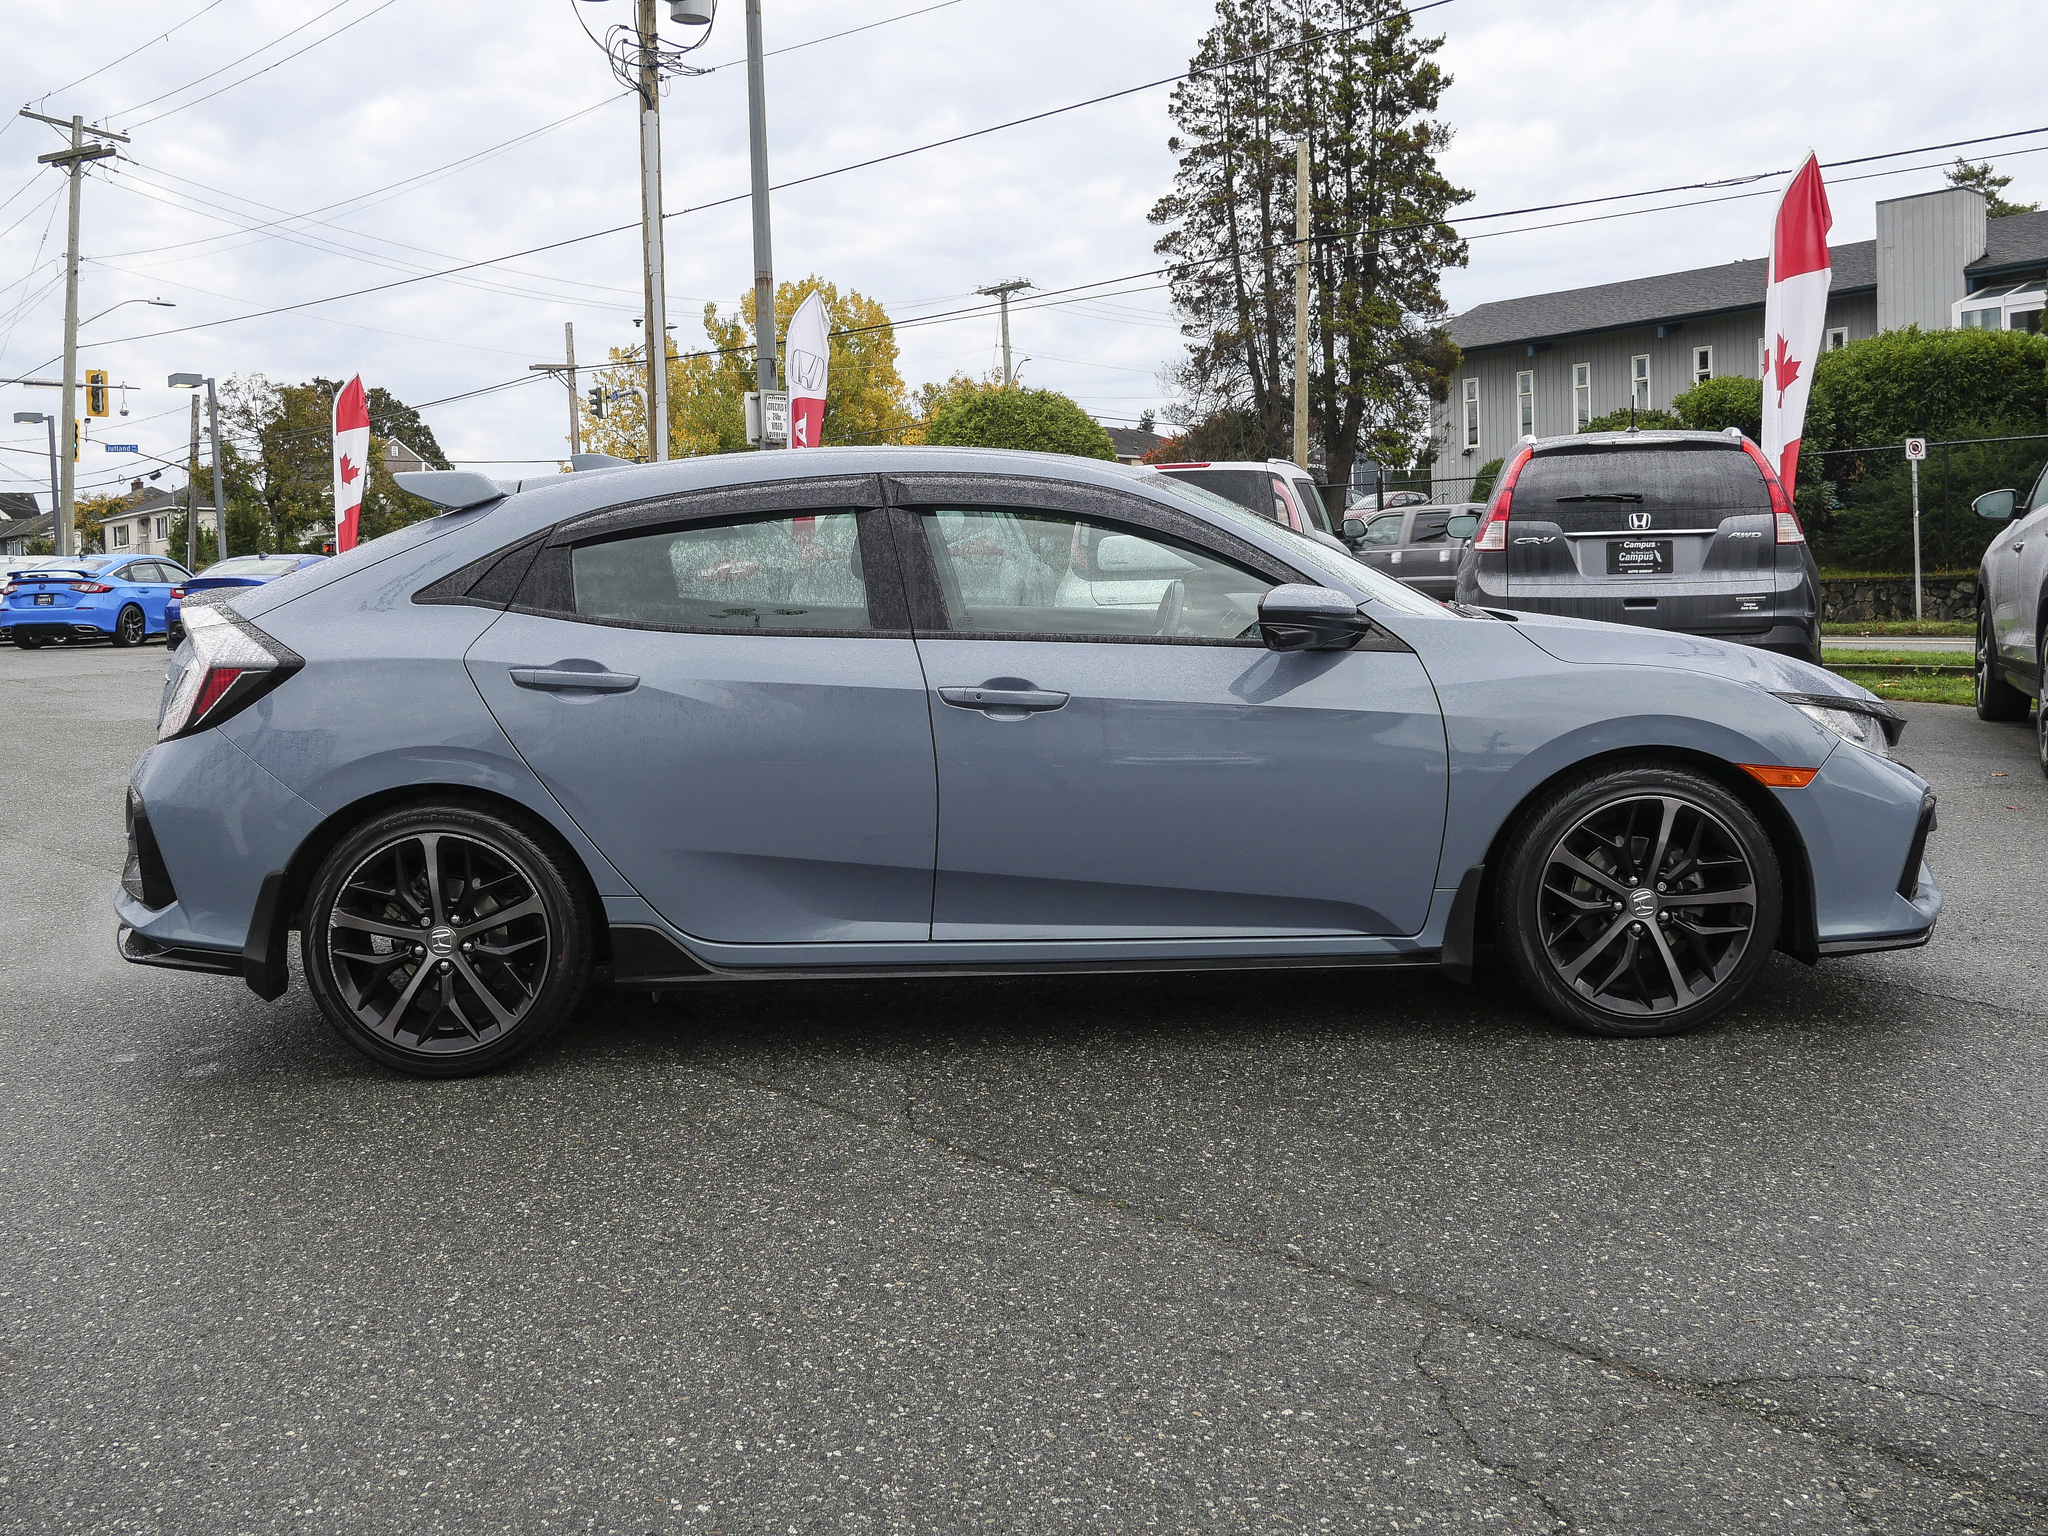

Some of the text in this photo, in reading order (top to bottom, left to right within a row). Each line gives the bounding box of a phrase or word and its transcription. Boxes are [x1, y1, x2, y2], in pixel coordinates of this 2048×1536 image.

[1728, 531, 1762, 539] AWD
[1513, 536, 1557, 545] CR-V
[1623, 541, 1656, 550] Campus
[1618, 552, 1654, 563] Campus
